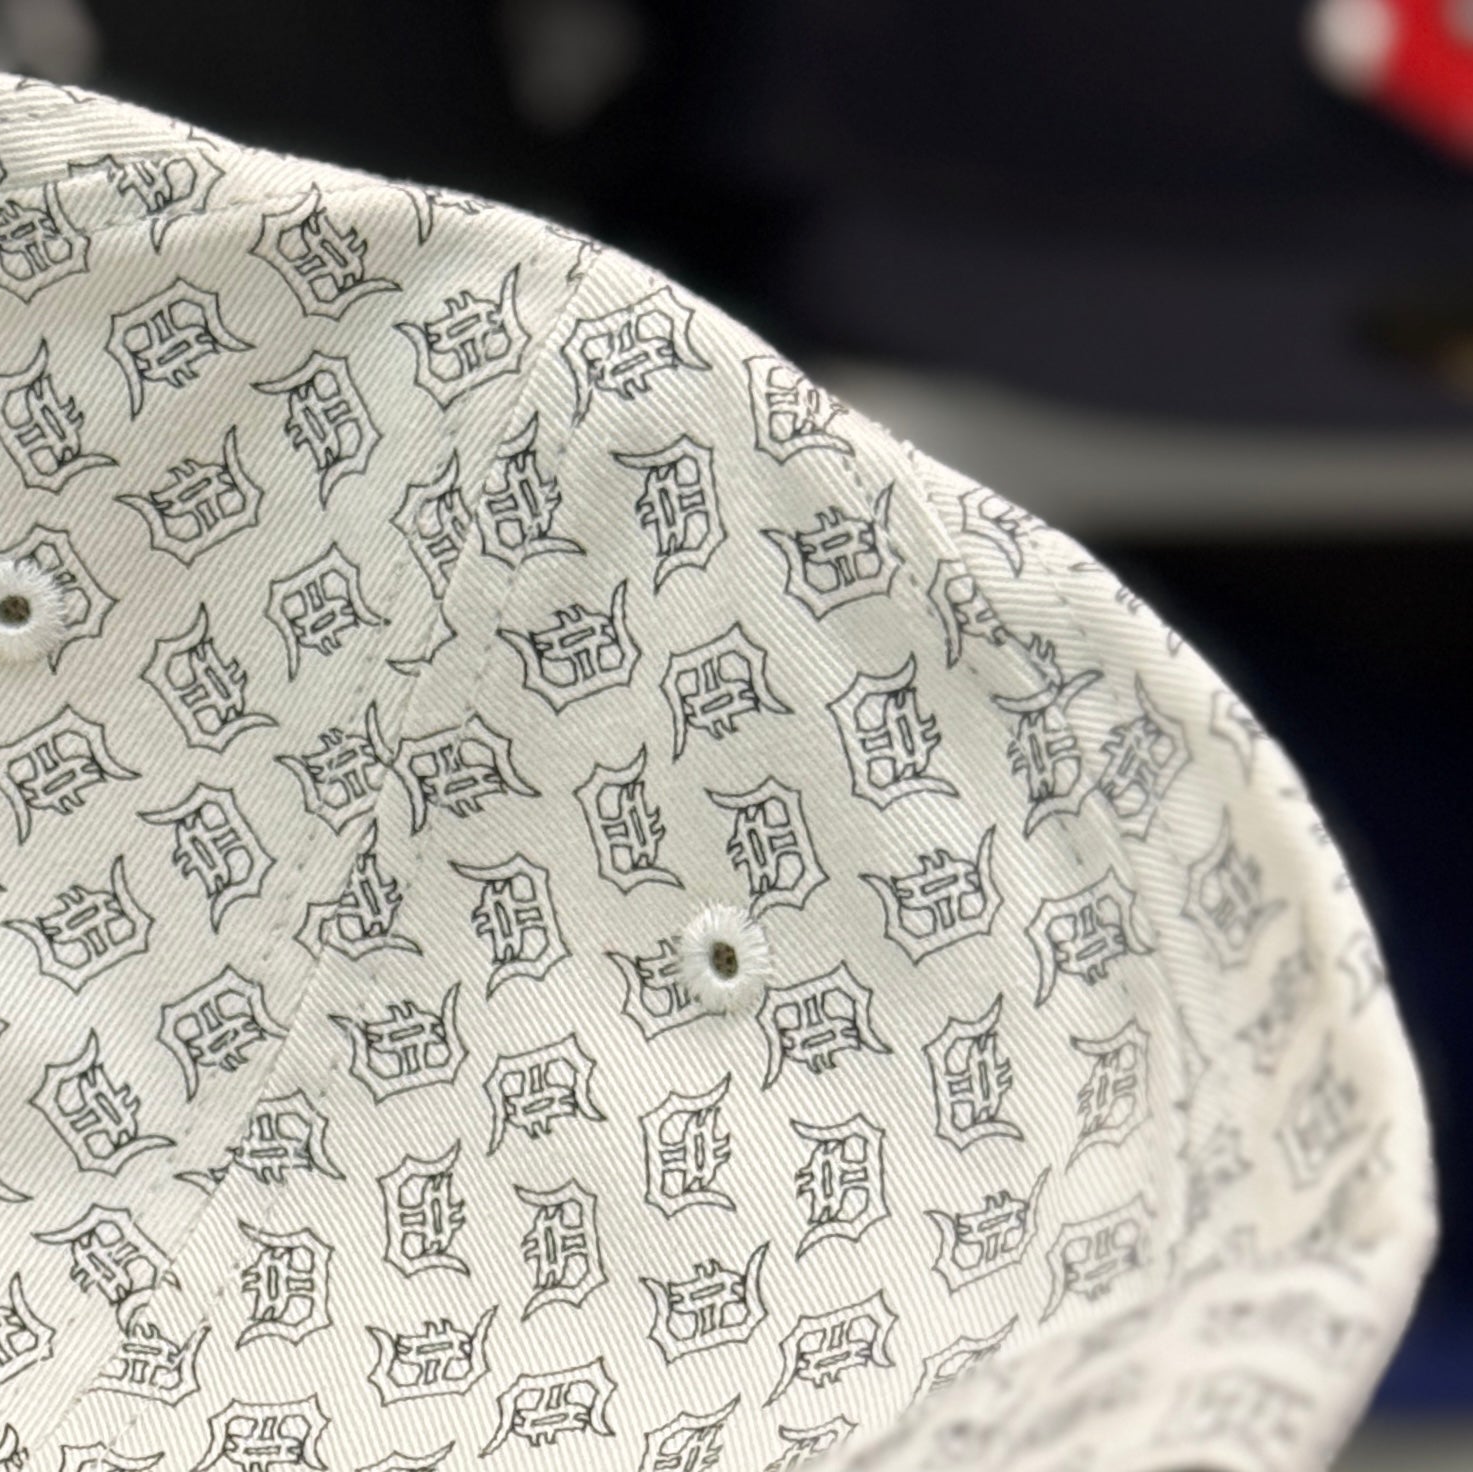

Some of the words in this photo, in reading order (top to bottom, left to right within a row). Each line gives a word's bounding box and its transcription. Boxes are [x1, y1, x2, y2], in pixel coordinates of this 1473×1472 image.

[246, 182, 404, 323] D
[103, 274, 257, 422] D
[391, 256, 537, 414] D
[112, 424, 266, 569] D
[249, 348, 385, 511] D
[608, 432, 730, 597] D
[758, 479, 906, 623] D
[137, 601, 281, 756] D
[263, 539, 392, 683] D
[495, 577, 644, 717] D
[658, 619, 795, 765] D
[825, 651, 961, 813] D
[390, 714, 541, 835] D
[571, 741, 686, 897] D
[136, 780, 278, 935] D
[703, 774, 831, 924] D
[857, 823, 1005, 968] D
[0, 853, 156, 996] D
[447, 851, 573, 1002] D
[1023, 866, 1158, 1010] D
[154, 962, 290, 1104] D
[326, 980, 470, 1107] D
[482, 1031, 609, 1158] D
[754, 959, 895, 1093] D
[921, 991, 1026, 1155] D
[1065, 1017, 1151, 1174] D
[25, 1027, 178, 1179] D
[637, 1071, 737, 1221] D
[375, 1138, 472, 1280] D
[512, 1177, 609, 1324] D
[789, 1111, 892, 1264] D
[923, 1165, 1052, 1297] D
[235, 1217, 336, 1352] D
[364, 1304, 500, 1408] D
[638, 1240, 771, 1368] D
[762, 1288, 900, 1409] D
[477, 1355, 618, 1460] D
